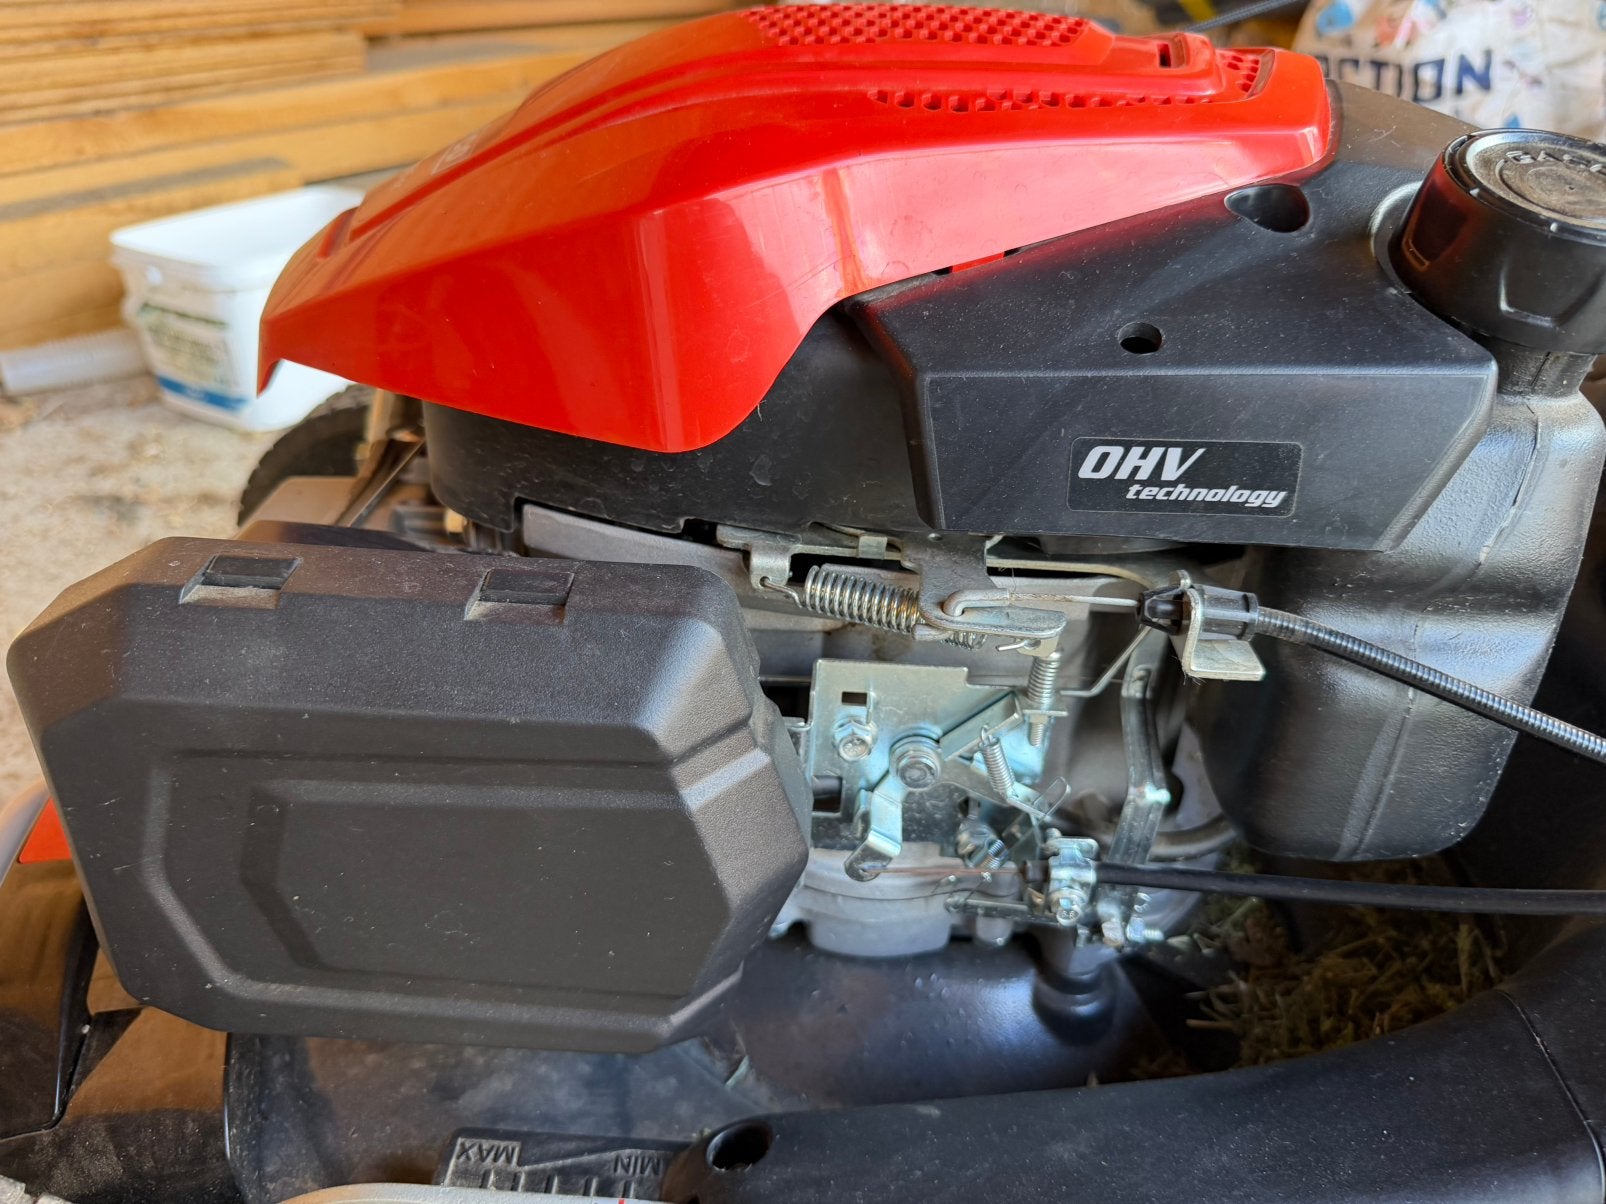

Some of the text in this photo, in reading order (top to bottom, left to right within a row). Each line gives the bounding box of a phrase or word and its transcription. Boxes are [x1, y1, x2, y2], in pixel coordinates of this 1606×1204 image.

[1078, 445, 1206, 481] OHV
[1126, 484, 1287, 507] technology
[457, 1139, 518, 1165] MAX
[613, 1153, 661, 1175] MIN
